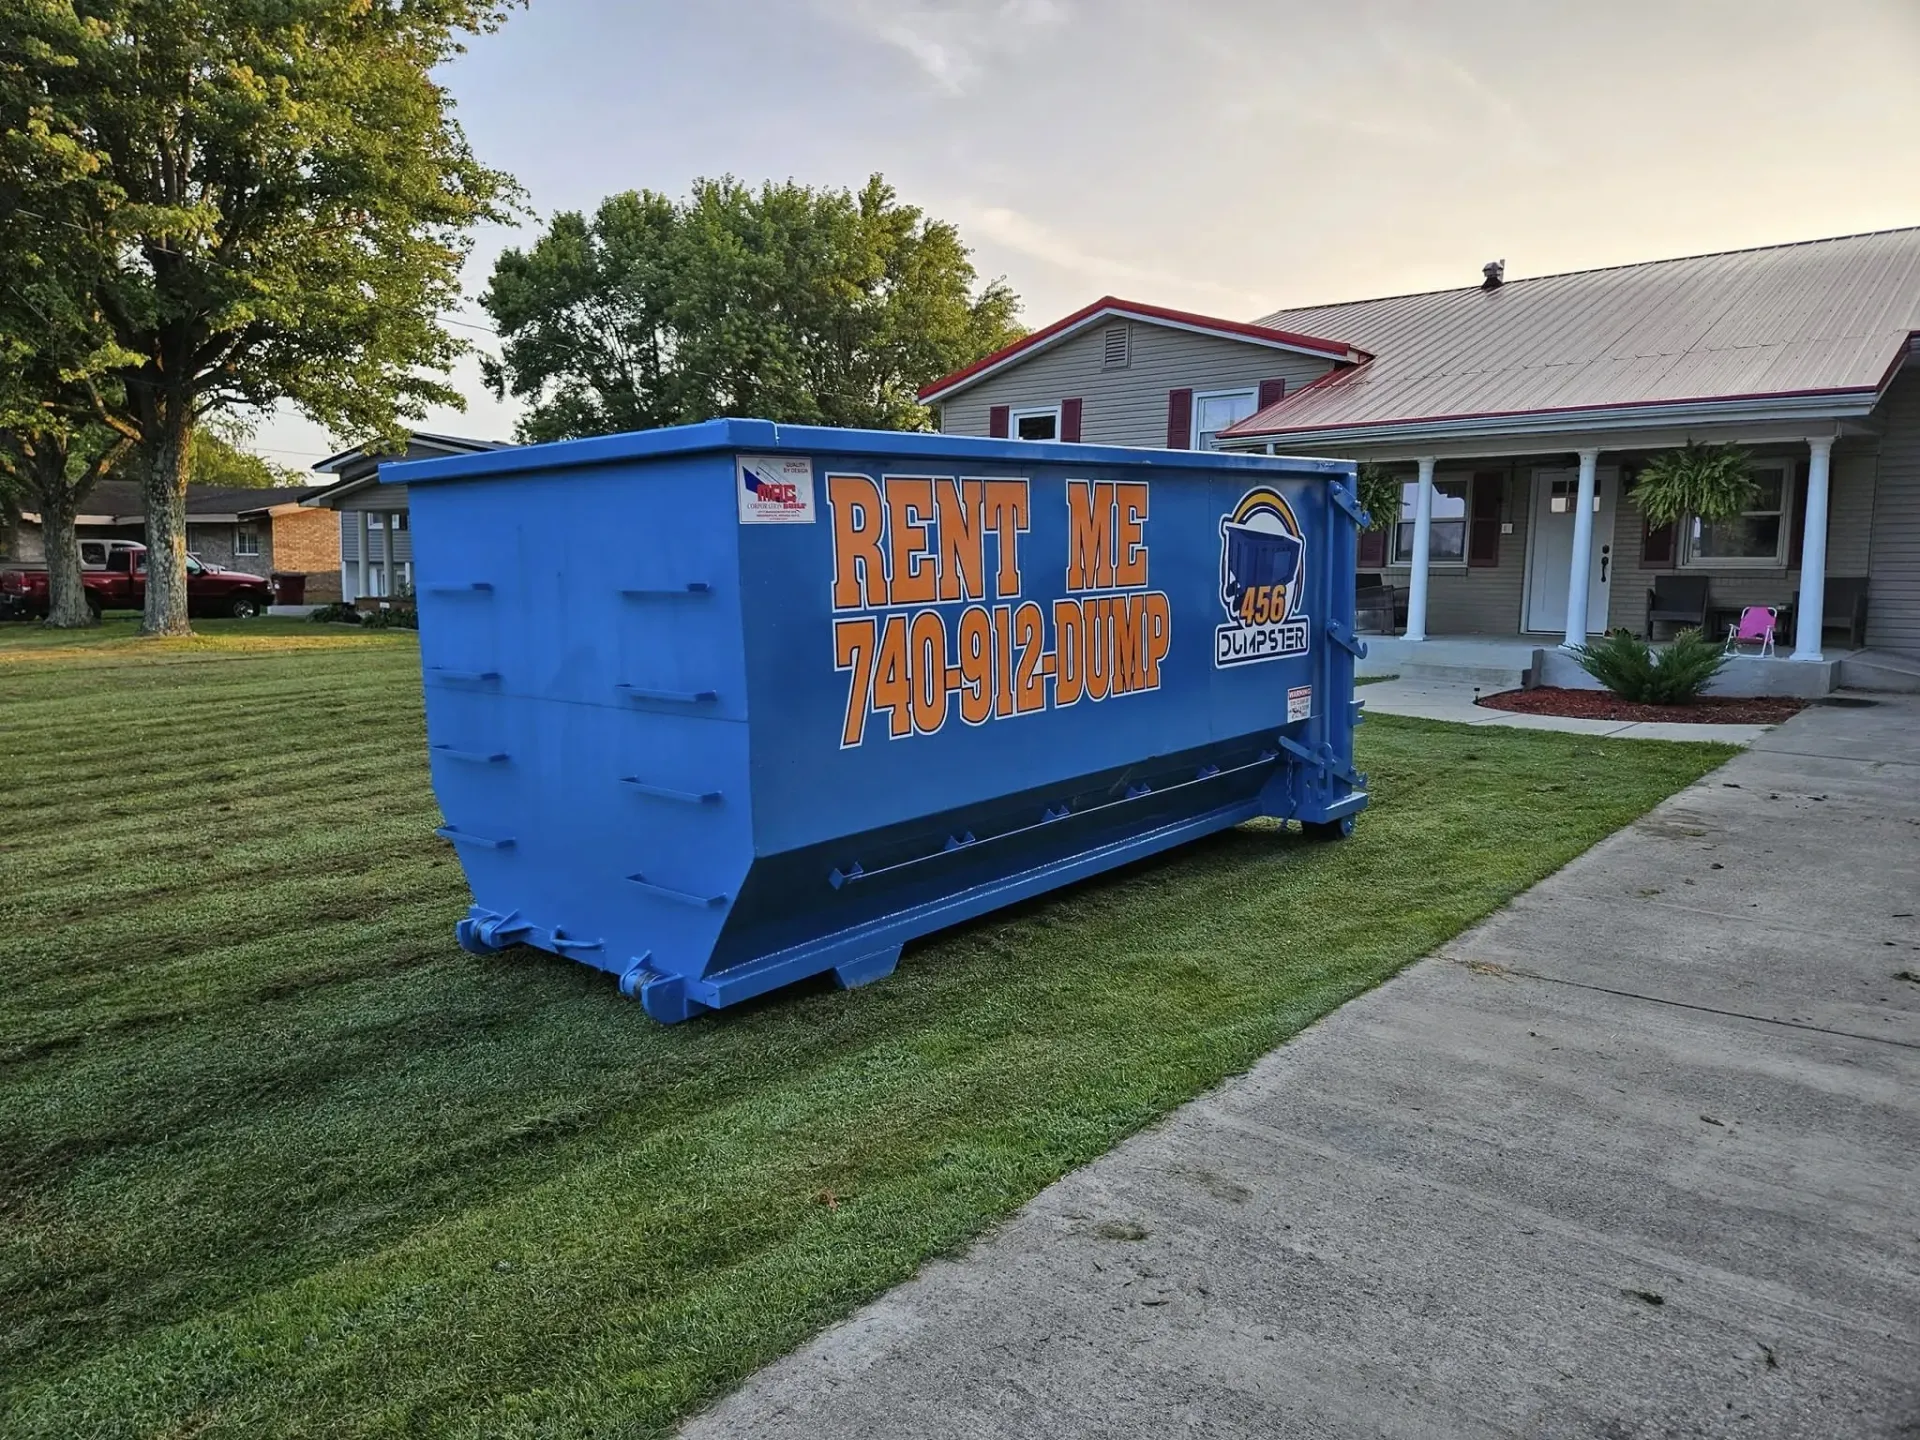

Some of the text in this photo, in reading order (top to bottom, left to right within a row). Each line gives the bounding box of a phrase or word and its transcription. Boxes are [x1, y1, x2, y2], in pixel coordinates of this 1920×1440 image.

[826, 472, 1149, 612] RENT ME
[1221, 627, 1304, 658] DUMPSTER
[1240, 585, 1287, 627] 456
[833, 591, 1171, 750] 740-912-DUMP
